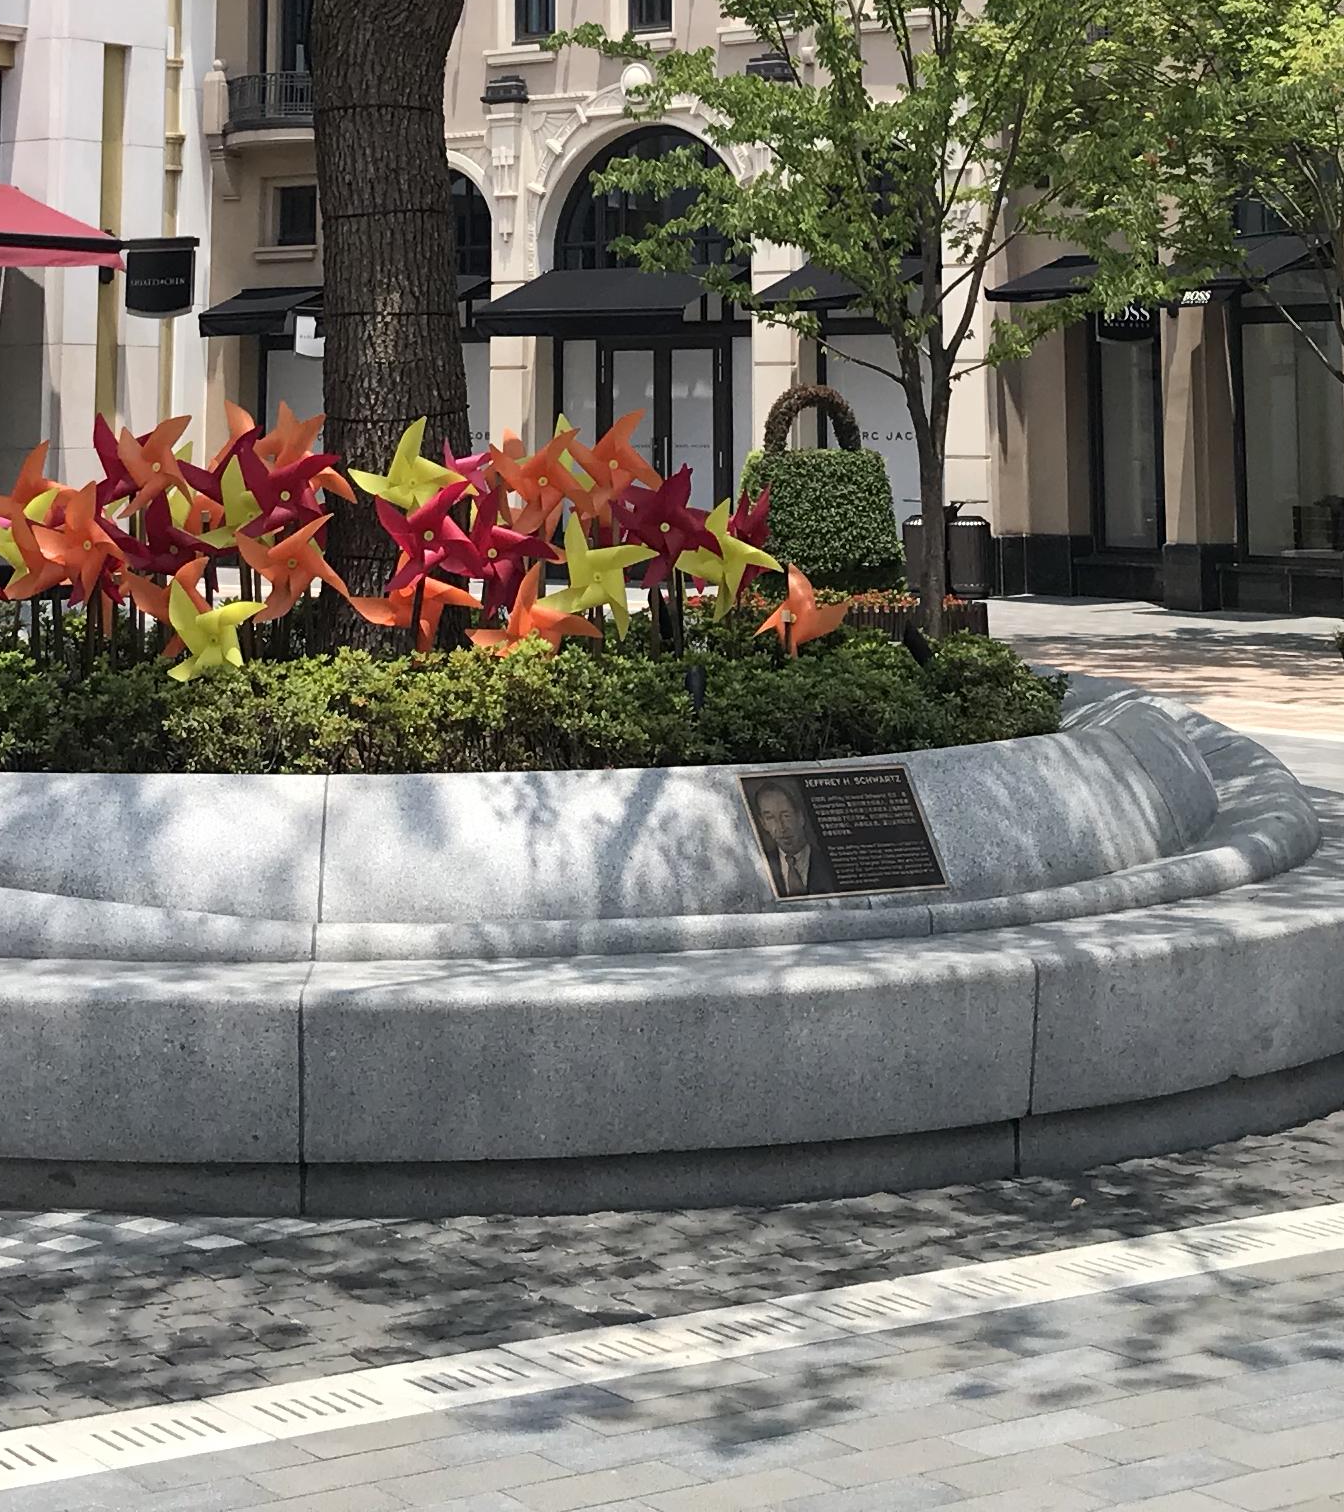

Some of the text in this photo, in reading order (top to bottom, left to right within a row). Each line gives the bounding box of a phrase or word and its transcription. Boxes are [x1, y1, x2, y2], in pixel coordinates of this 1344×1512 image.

[1182, 290, 1212, 301] BOSS
[862, 431, 914, 441] RC JAC
[804, 777, 841, 788] JEFFREY
[854, 774, 901, 785] SCHWARTZ
